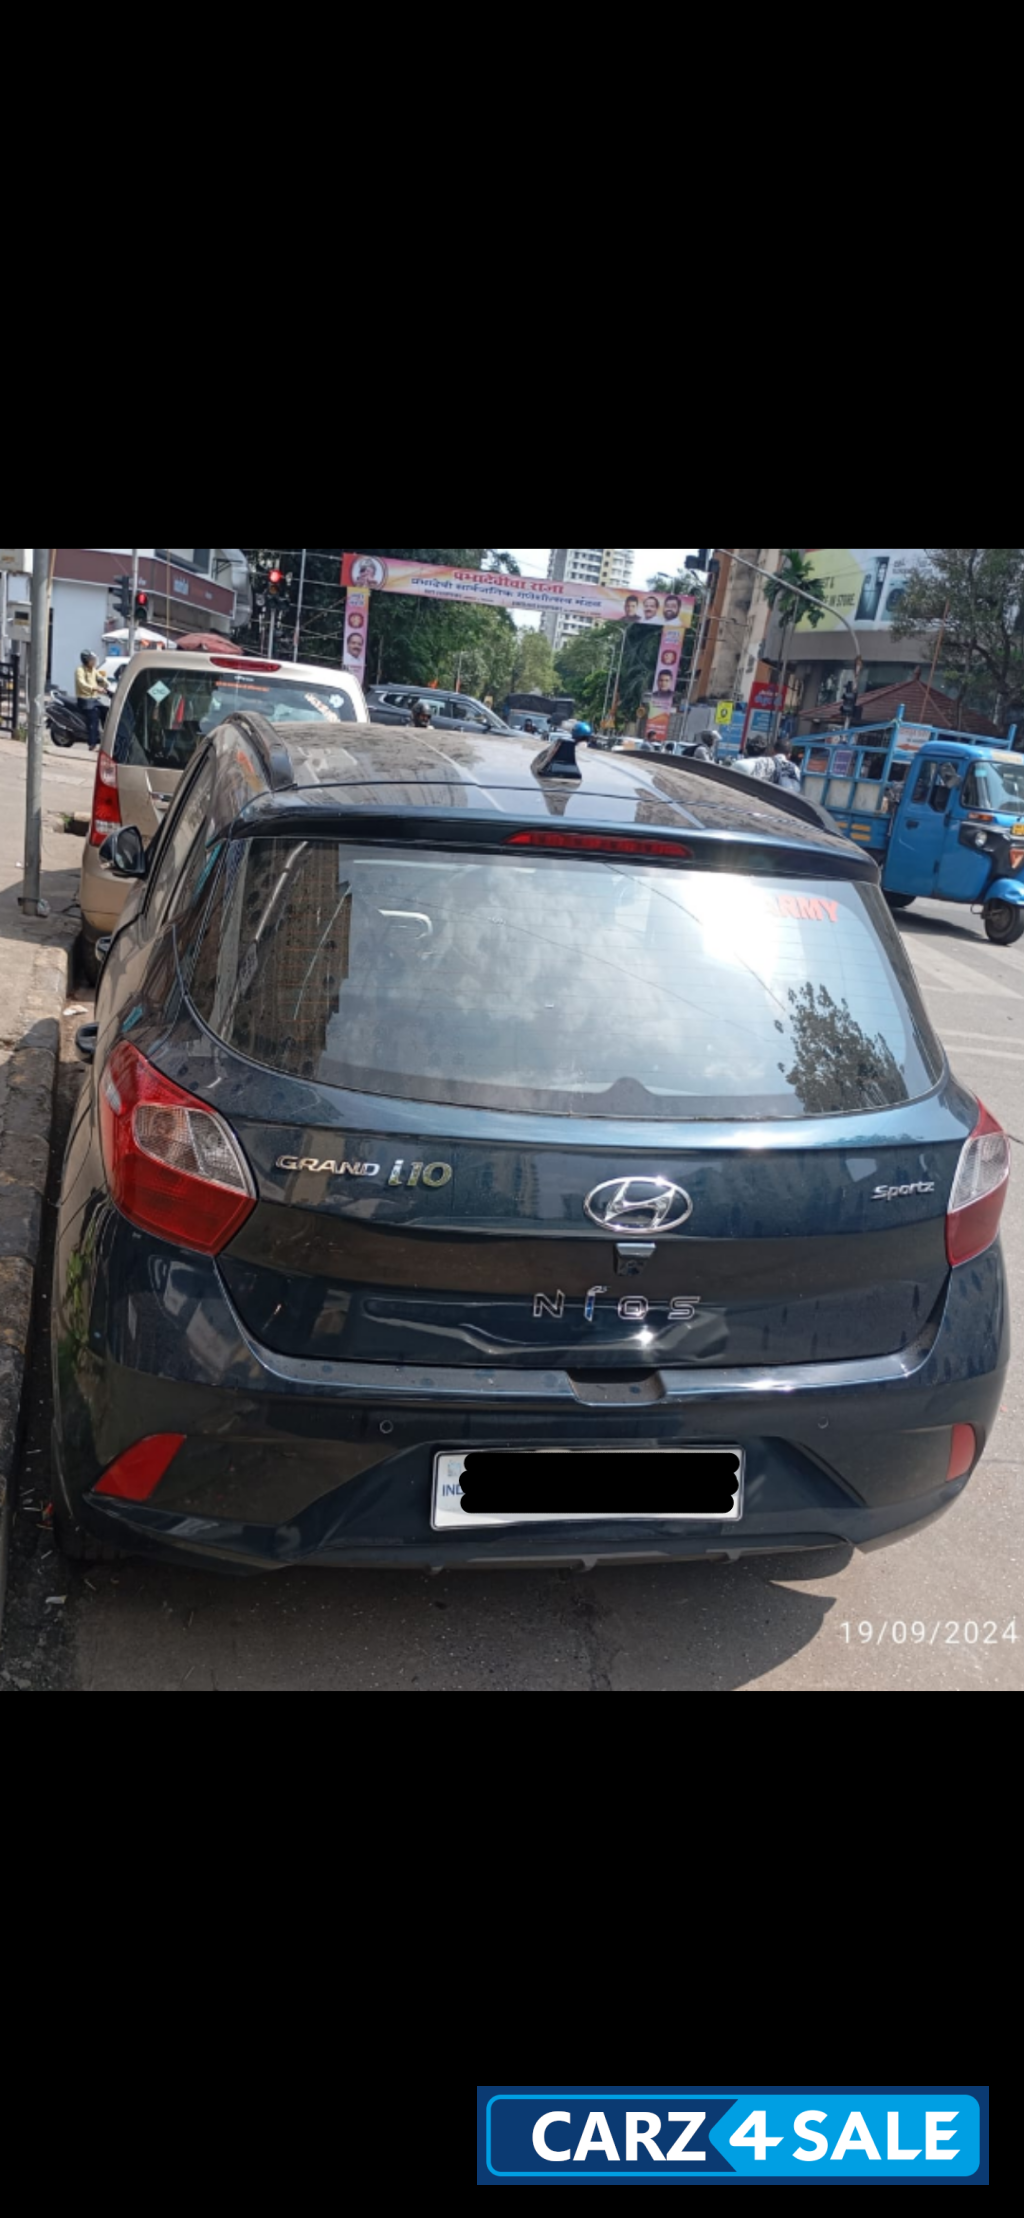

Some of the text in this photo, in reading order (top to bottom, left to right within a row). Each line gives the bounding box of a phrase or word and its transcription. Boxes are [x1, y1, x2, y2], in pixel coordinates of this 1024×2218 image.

[530, 581, 564, 595] राजा
[275, 1155, 453, 1188] GRAND i10
[871, 1180, 935, 1201] Sportz
